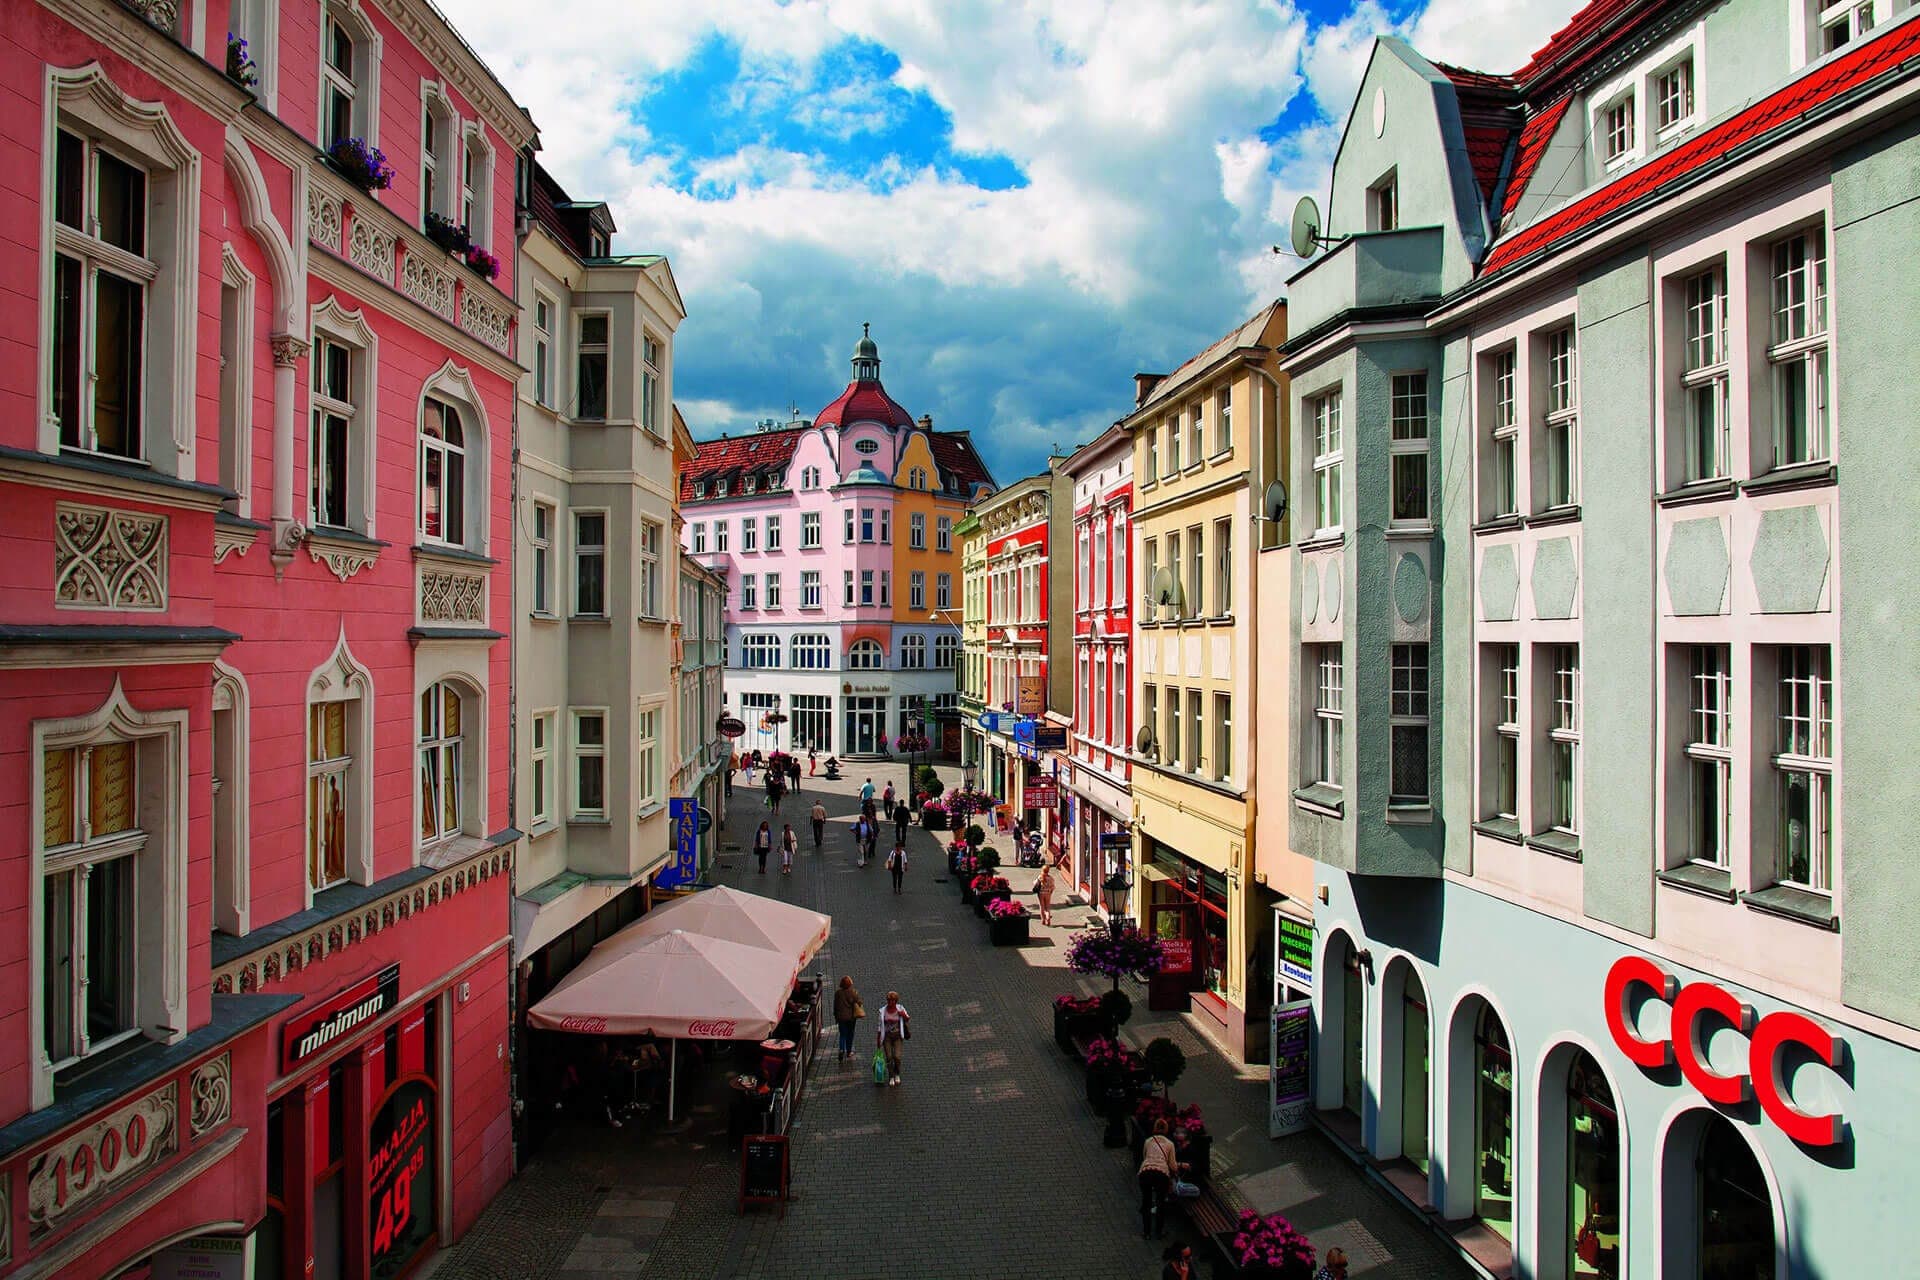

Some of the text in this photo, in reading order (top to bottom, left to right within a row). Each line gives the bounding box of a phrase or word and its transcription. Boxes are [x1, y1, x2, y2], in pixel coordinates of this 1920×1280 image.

[298, 993, 384, 1059] minimum
[560, 1016, 608, 1033] Coca-Cola
[688, 1020, 737, 1037] Coca-Cola
[1604, 956, 1843, 1146] CCC
[50, 1113, 147, 1209] 1900
